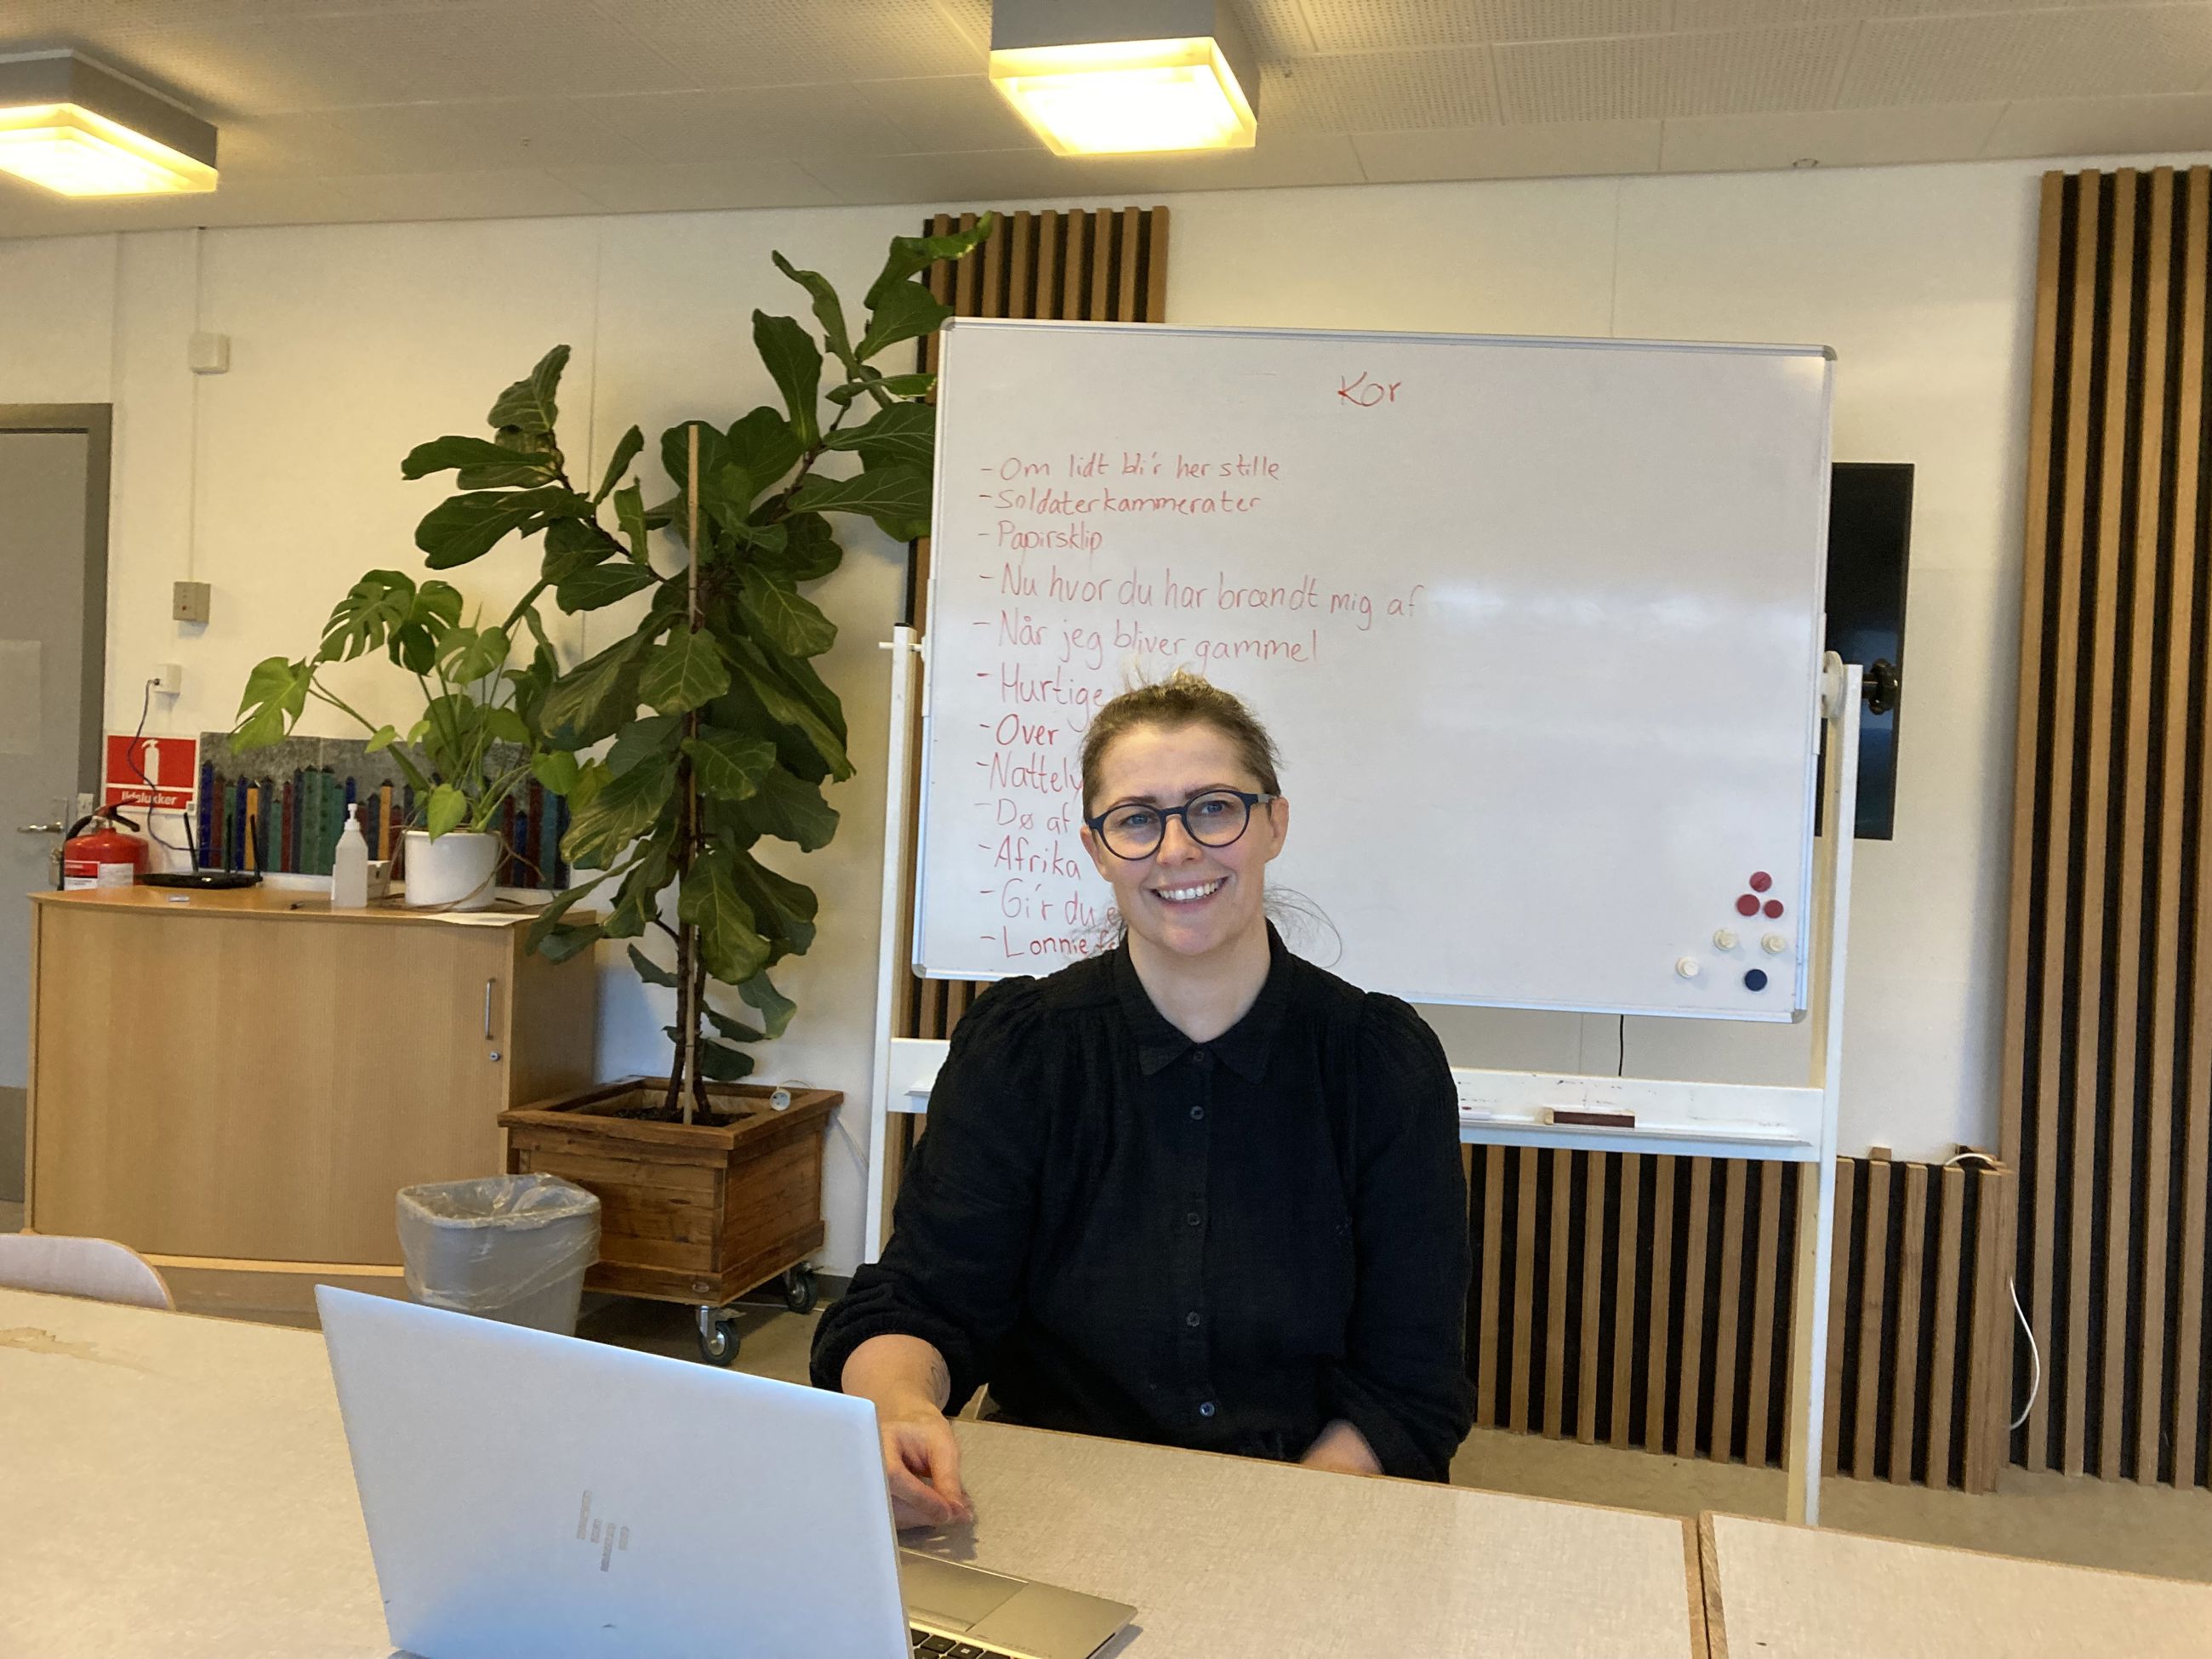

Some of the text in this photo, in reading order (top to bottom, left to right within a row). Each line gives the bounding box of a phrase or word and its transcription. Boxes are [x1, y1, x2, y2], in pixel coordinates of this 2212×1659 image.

[1337, 371, 1402, 407] Kor
[1069, 453, 1109, 477] lidt
[1177, 454, 1211, 478] her
[1219, 453, 1280, 480] stille
[1049, 565, 1112, 601] hvor
[1119, 567, 1152, 607] du
[1165, 567, 1208, 608] har
[1330, 592, 1372, 630] mig
[1387, 584, 1425, 617] af
[1060, 619, 1103, 670] jeg
[1114, 619, 1187, 656] bliver
[1195, 630, 1317, 676] gammel
[1046, 801, 1071, 835] af
[1064, 890, 1097, 927] du
